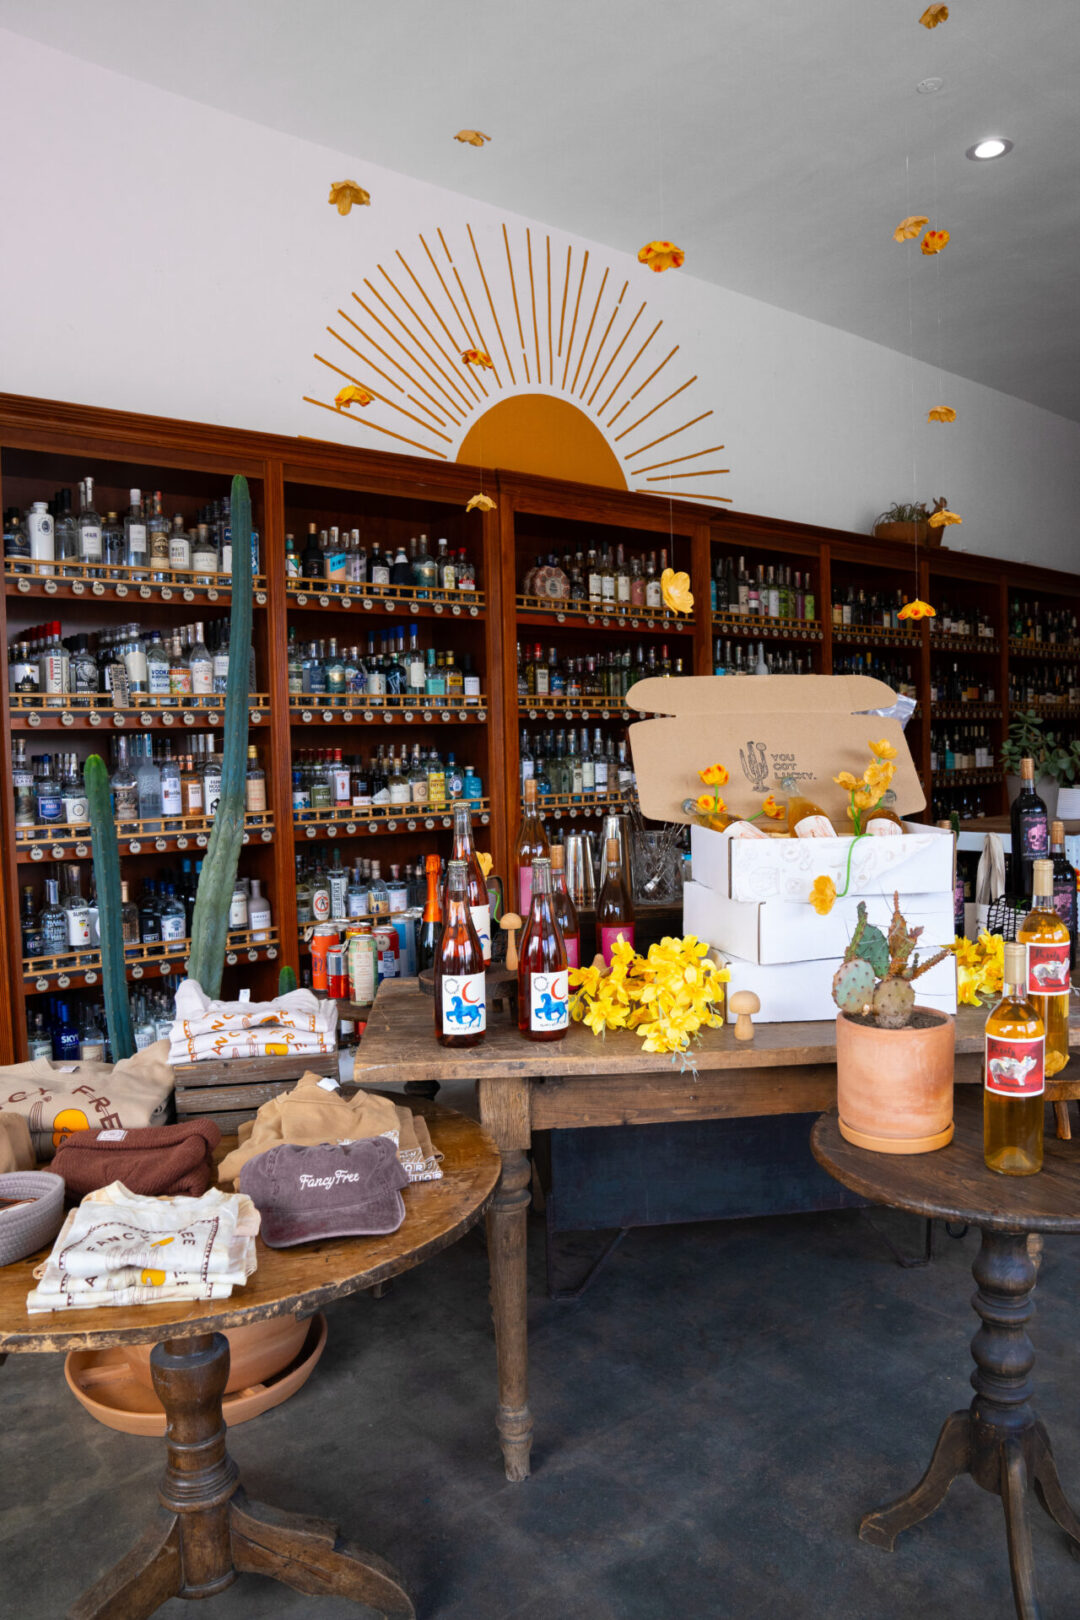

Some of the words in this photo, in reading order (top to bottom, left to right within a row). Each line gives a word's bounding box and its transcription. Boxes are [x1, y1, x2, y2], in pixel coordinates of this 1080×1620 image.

[770, 753, 795, 762] YOU
[773, 763, 798, 771] GOT
[299, 1173, 336, 1190] Fancy
[334, 1169, 360, 1184] Free
